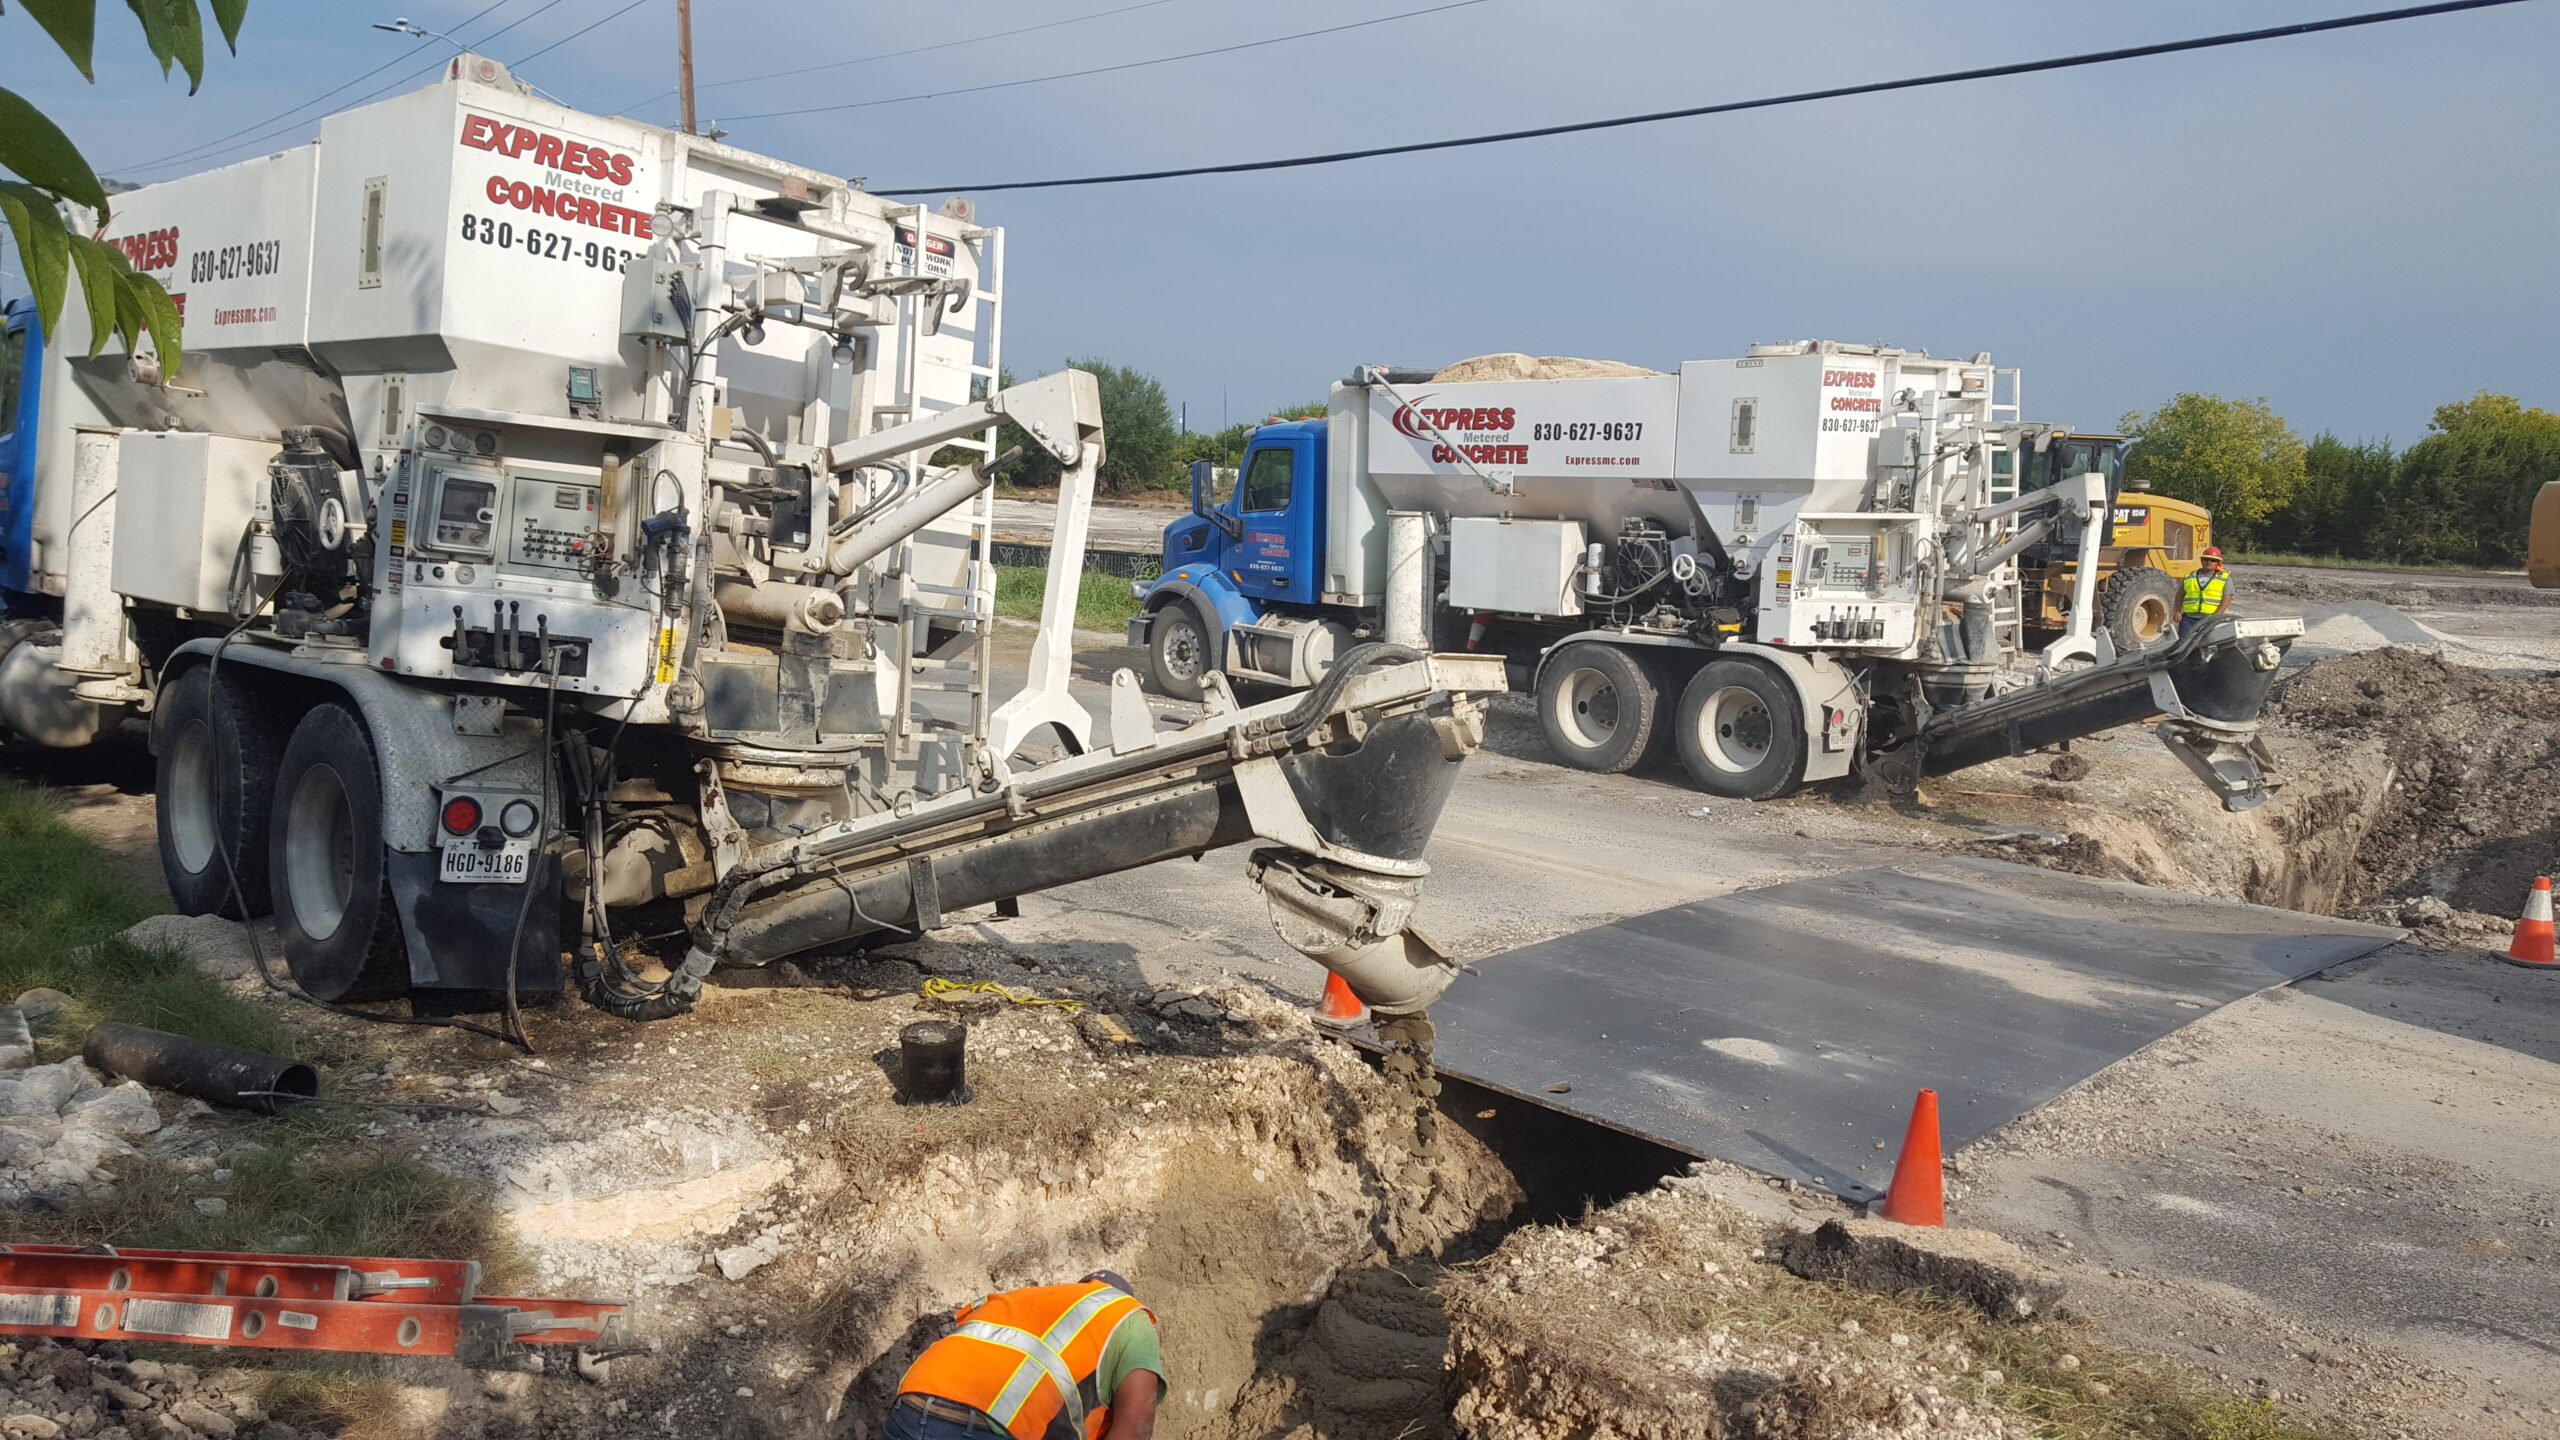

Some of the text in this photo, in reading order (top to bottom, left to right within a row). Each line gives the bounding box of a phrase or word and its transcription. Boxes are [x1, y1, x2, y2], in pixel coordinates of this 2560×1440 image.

[460, 113, 635, 186] EXPRESS
[544, 170, 624, 203] Metered
[486, 175, 653, 240] CONCRETE
[107, 226, 180, 272] PRESS
[907, 233, 944, 250] DGER
[191, 240, 280, 284] 830-627-9637
[926, 254, 951, 267] WORK
[214, 307, 277, 327] Expressmc.com
[1823, 370, 1876, 388] EXPRESS
[1831, 397, 1881, 412] CONCRETE
[1417, 407, 1516, 431] EXPRESS
[1822, 418, 1879, 433] 830-627-9637
[1463, 432, 1509, 443] Metered
[1534, 422, 1643, 441] 830-627-9637
[1432, 444, 1529, 465] CONCRETE
[1565, 455, 1640, 466] Expressmc.com
[2114, 508, 2130, 523] CAT
